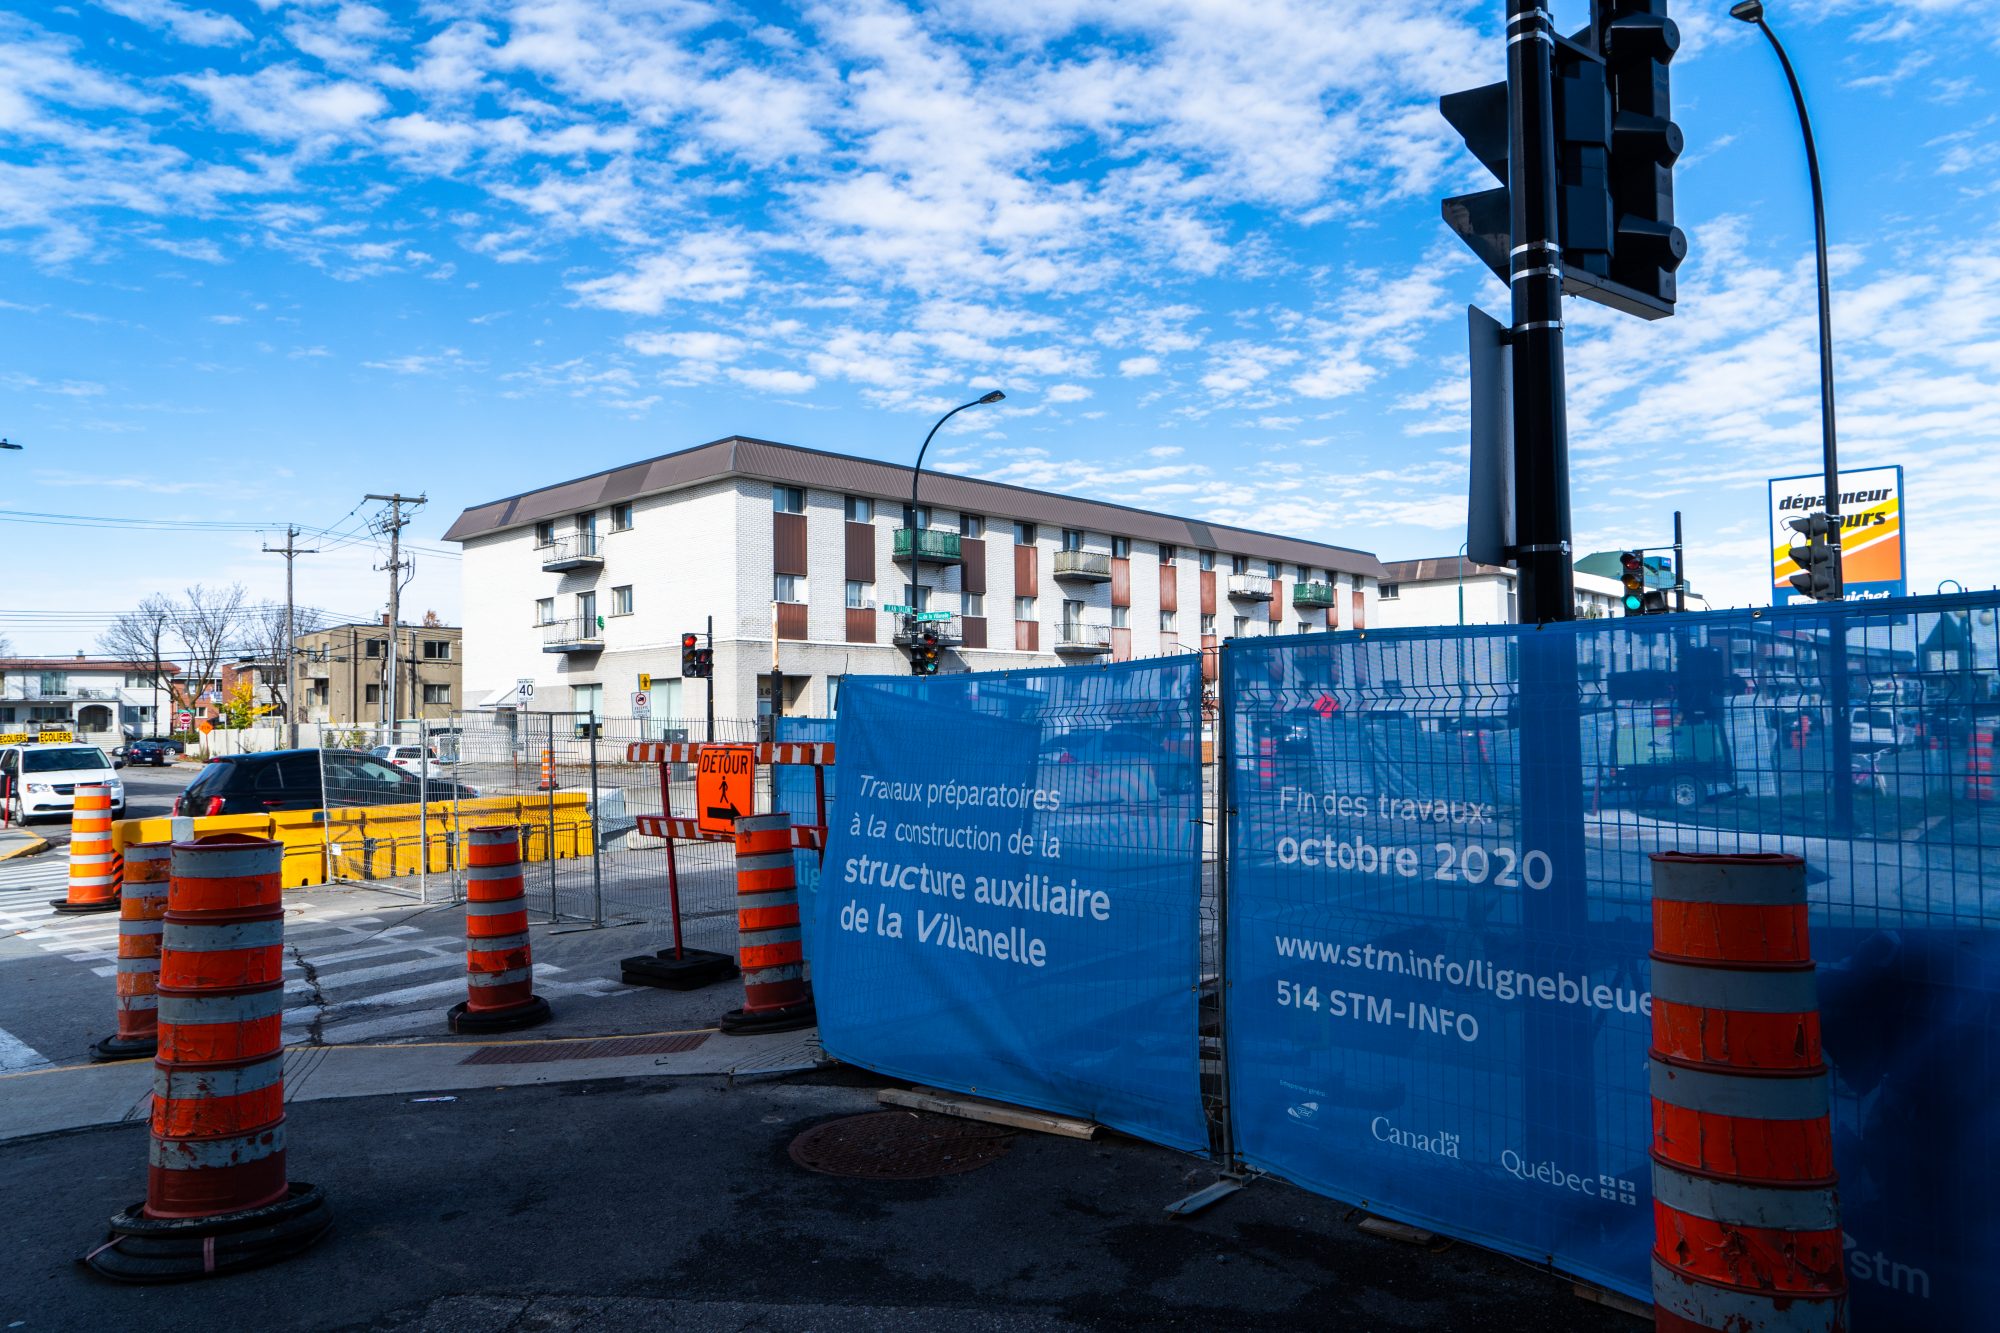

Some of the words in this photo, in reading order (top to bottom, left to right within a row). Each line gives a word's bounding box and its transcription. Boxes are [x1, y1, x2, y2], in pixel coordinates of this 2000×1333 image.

[1779, 487, 1893, 511] dépaneur
[519, 684, 534, 696] 40
[40, 732, 72, 742] ECOLIERS
[702, 750, 748, 775] DÉTOUR
[859, 774, 922, 801] Travaux
[927, 778, 1061, 812] préparatoires
[1280, 786, 1317, 813] Fin
[1323, 790, 1368, 818] des
[1378, 793, 1493, 824] travaux:
[850, 812, 861, 836] à
[867, 815, 886, 838] la
[895, 821, 1001, 852] construction
[1007, 829, 1034, 856] de
[1041, 831, 1060, 858] la
[1277, 835, 1418, 877] octobre
[1434, 843, 1553, 890] 2020
[844, 855, 965, 900] structure
[974, 873, 1111, 921] auxiliaire
[840, 900, 868, 933] de
[876, 903, 902, 938] la
[916, 909, 1047, 967] Villanelle
[1275, 935, 1652, 1018] www.stm.info/lignebleue
[1276, 980, 1320, 1012] 514
[1330, 990, 1479, 1042] STM-INFO
[1371, 1116, 1460, 1160] Canada
[1501, 1150, 1595, 1196] Québec
[1850, 1251, 1930, 1298] stm
